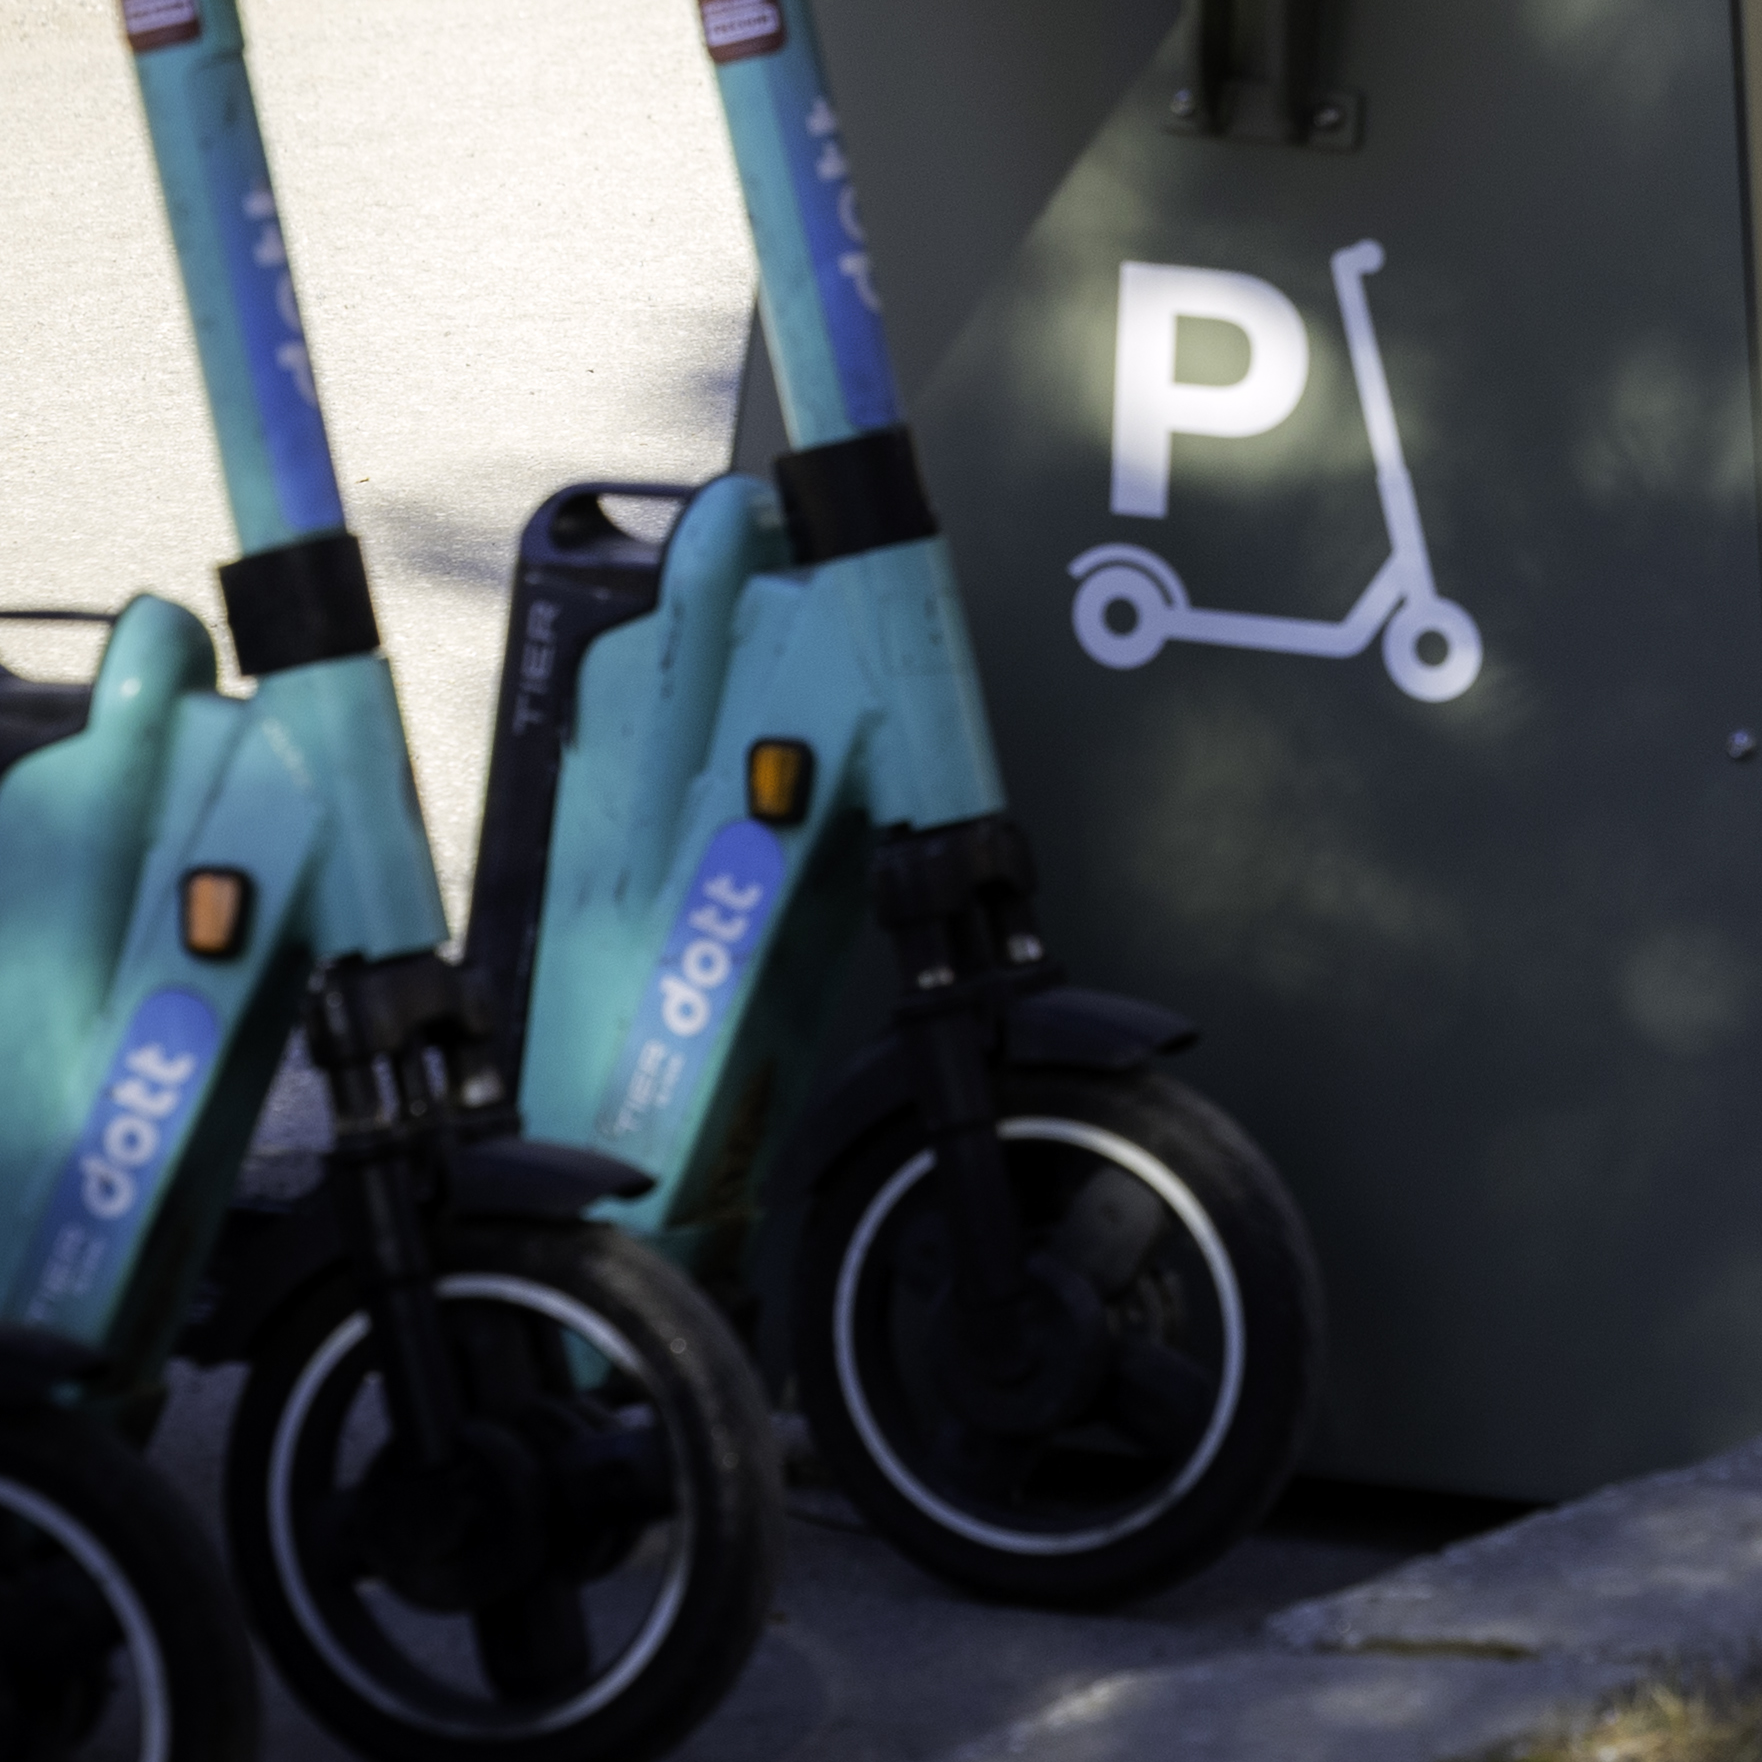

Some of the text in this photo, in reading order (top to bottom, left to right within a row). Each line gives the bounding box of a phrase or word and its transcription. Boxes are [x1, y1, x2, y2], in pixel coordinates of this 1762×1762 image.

[1109, 260, 1310, 519] P
[512, 600, 561, 736] TIER
[658, 872, 764, 1039] dott
[78, 1041, 196, 1220] dott
